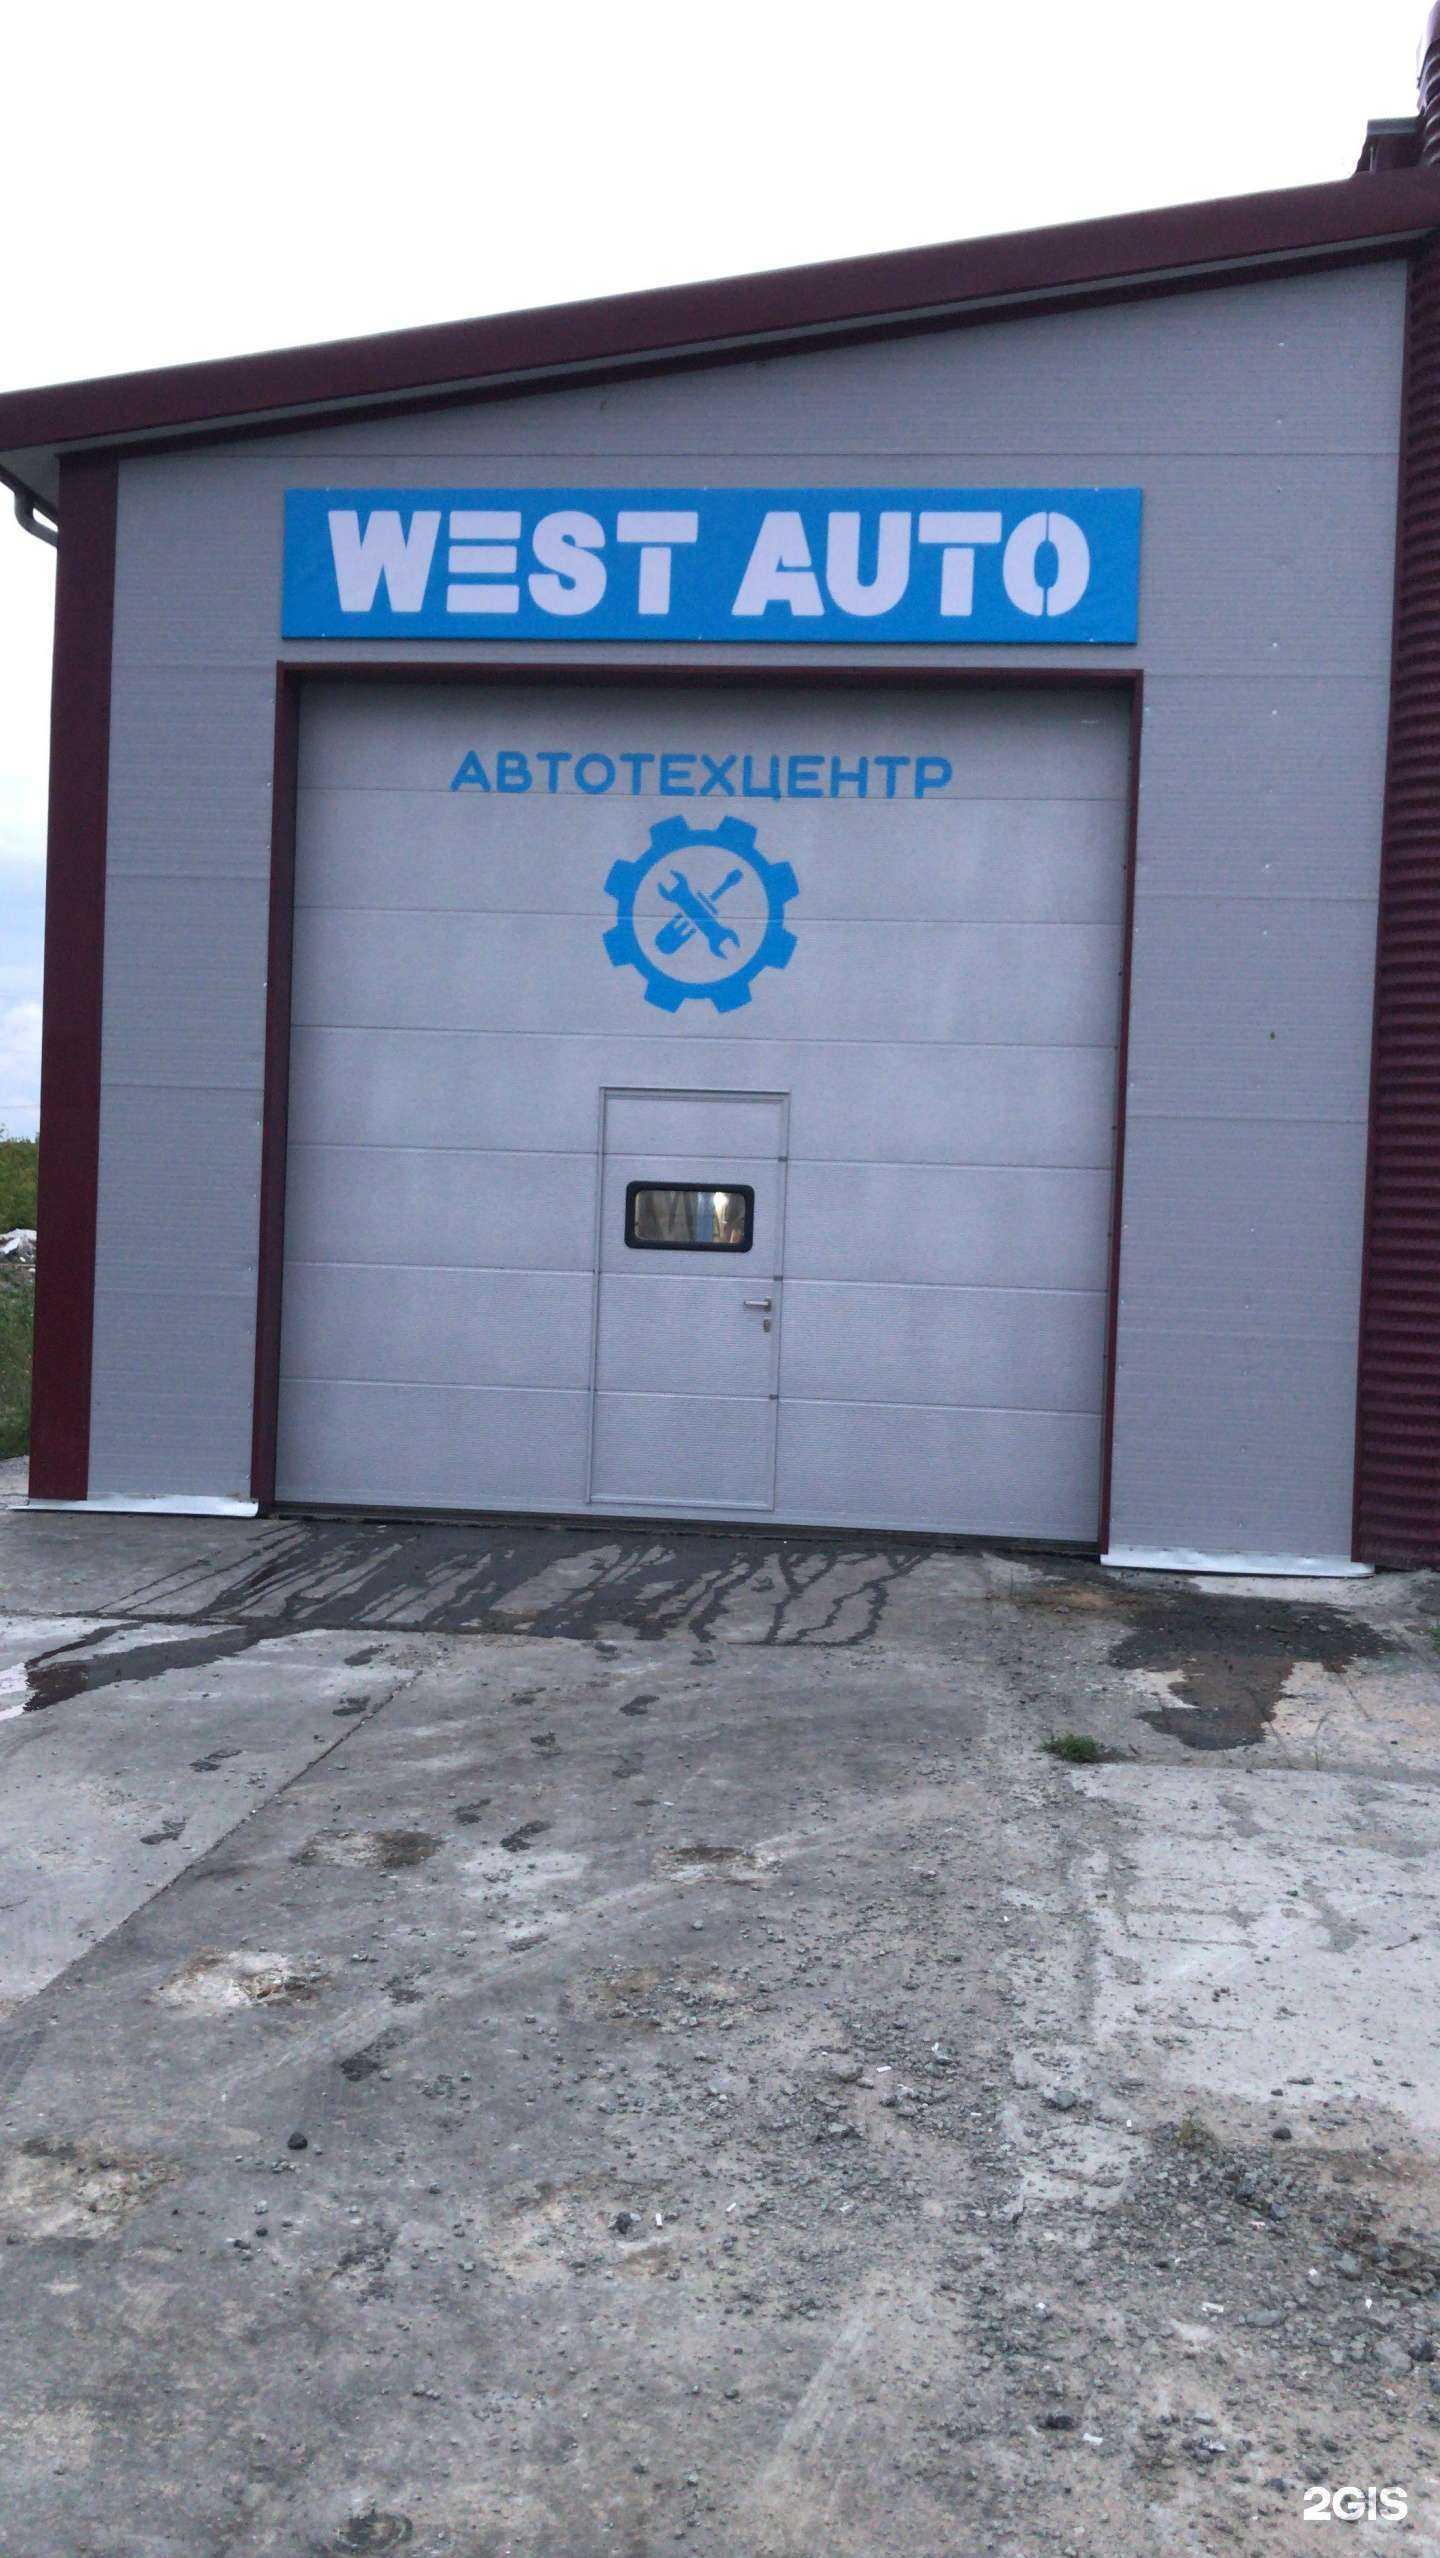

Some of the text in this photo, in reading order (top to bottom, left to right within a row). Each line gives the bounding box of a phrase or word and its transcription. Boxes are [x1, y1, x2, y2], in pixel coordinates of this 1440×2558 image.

[328, 510, 1092, 616] WEST AUTO
[450, 750, 954, 802] АВТОТЕХЦЕНТР
